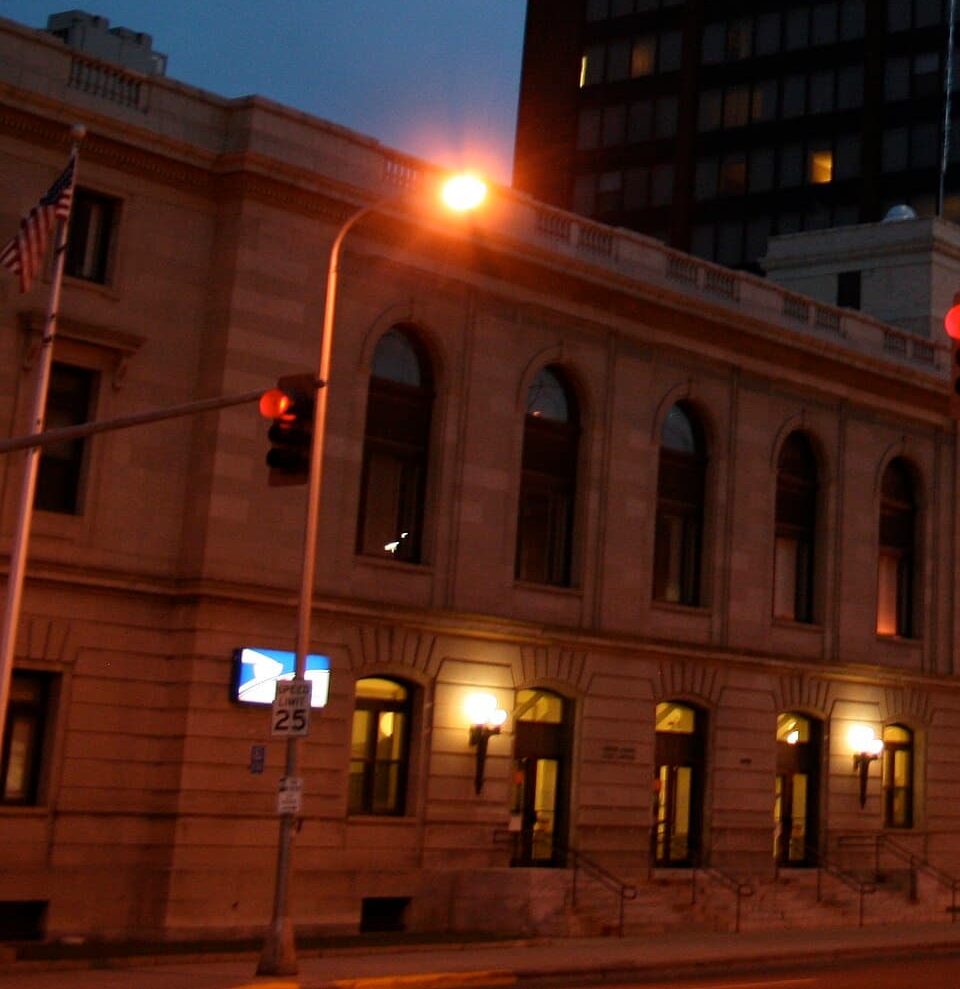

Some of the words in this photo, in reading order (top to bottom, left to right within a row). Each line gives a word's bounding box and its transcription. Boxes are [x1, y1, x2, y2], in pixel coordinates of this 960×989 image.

[278, 683, 310, 694] SPEED
[278, 696, 305, 708] LIMIT
[274, 709, 306, 731] 25
